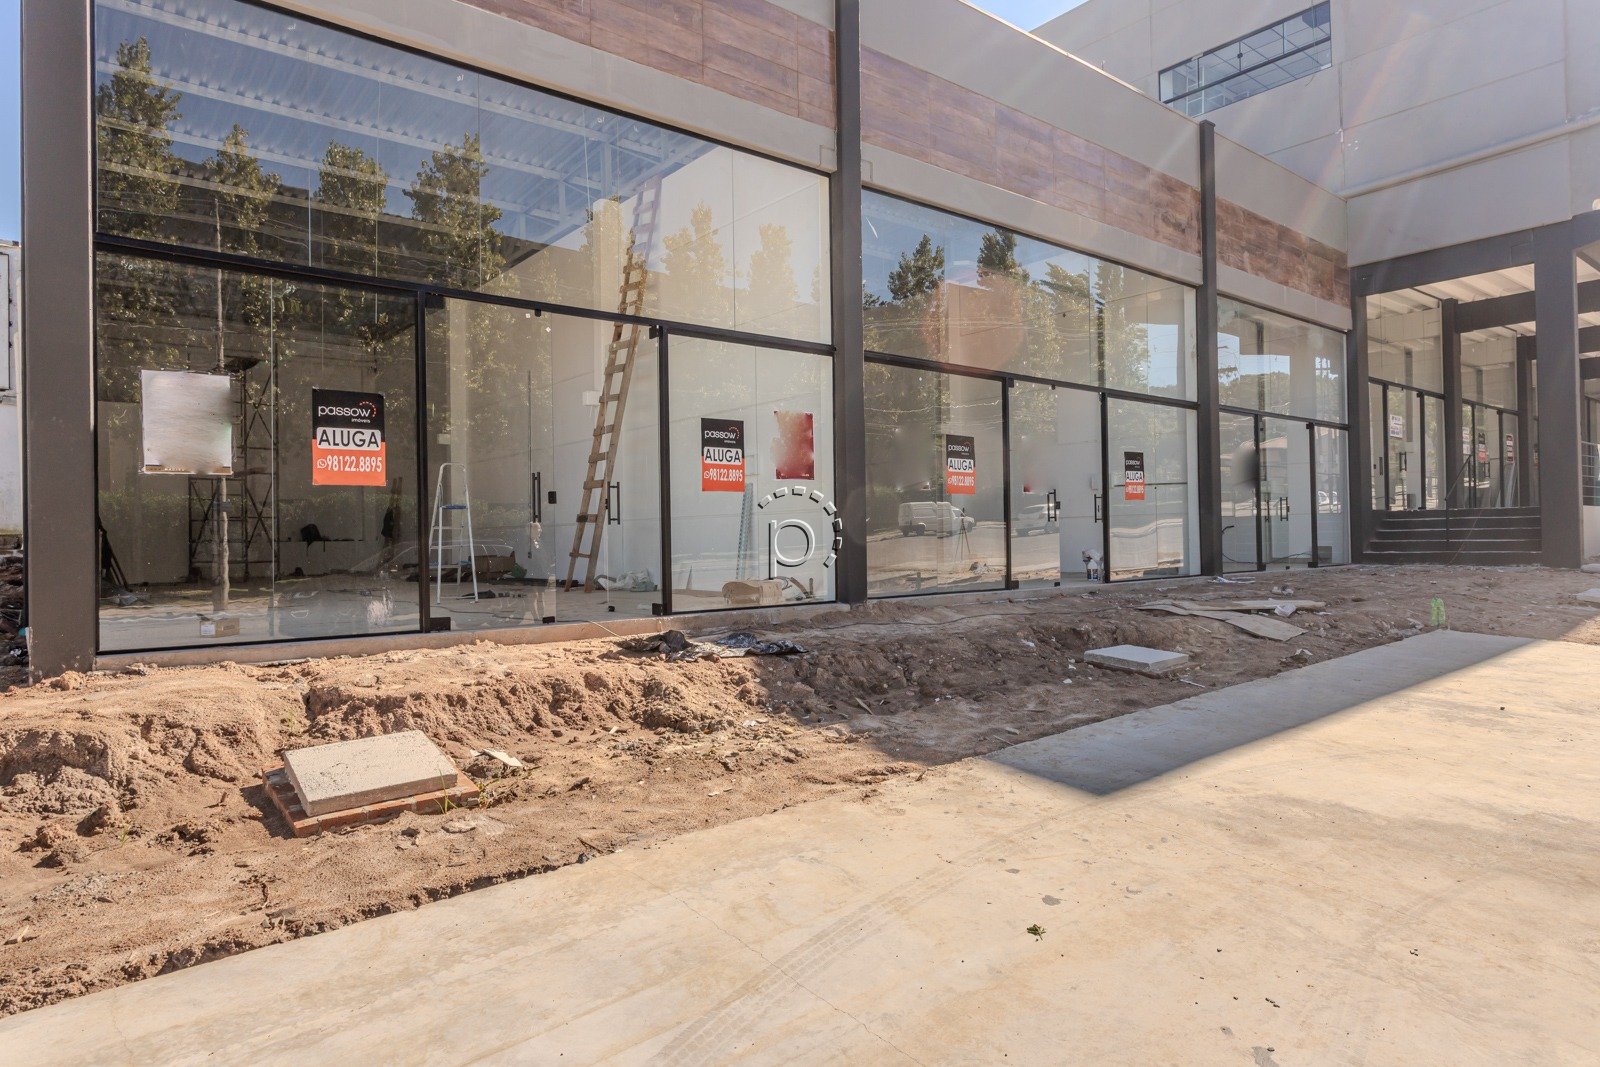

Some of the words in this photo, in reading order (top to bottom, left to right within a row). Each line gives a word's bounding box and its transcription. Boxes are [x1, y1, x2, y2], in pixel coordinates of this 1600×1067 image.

[318, 405, 371, 418] passow
[318, 429, 380, 448] ALUGA
[704, 430, 737, 439] passow
[704, 448, 741, 463] ALUGA
[326, 455, 383, 472] 98122.8895
[948, 459, 973, 471] ALUGA
[709, 468, 743, 482] 98122.8895
